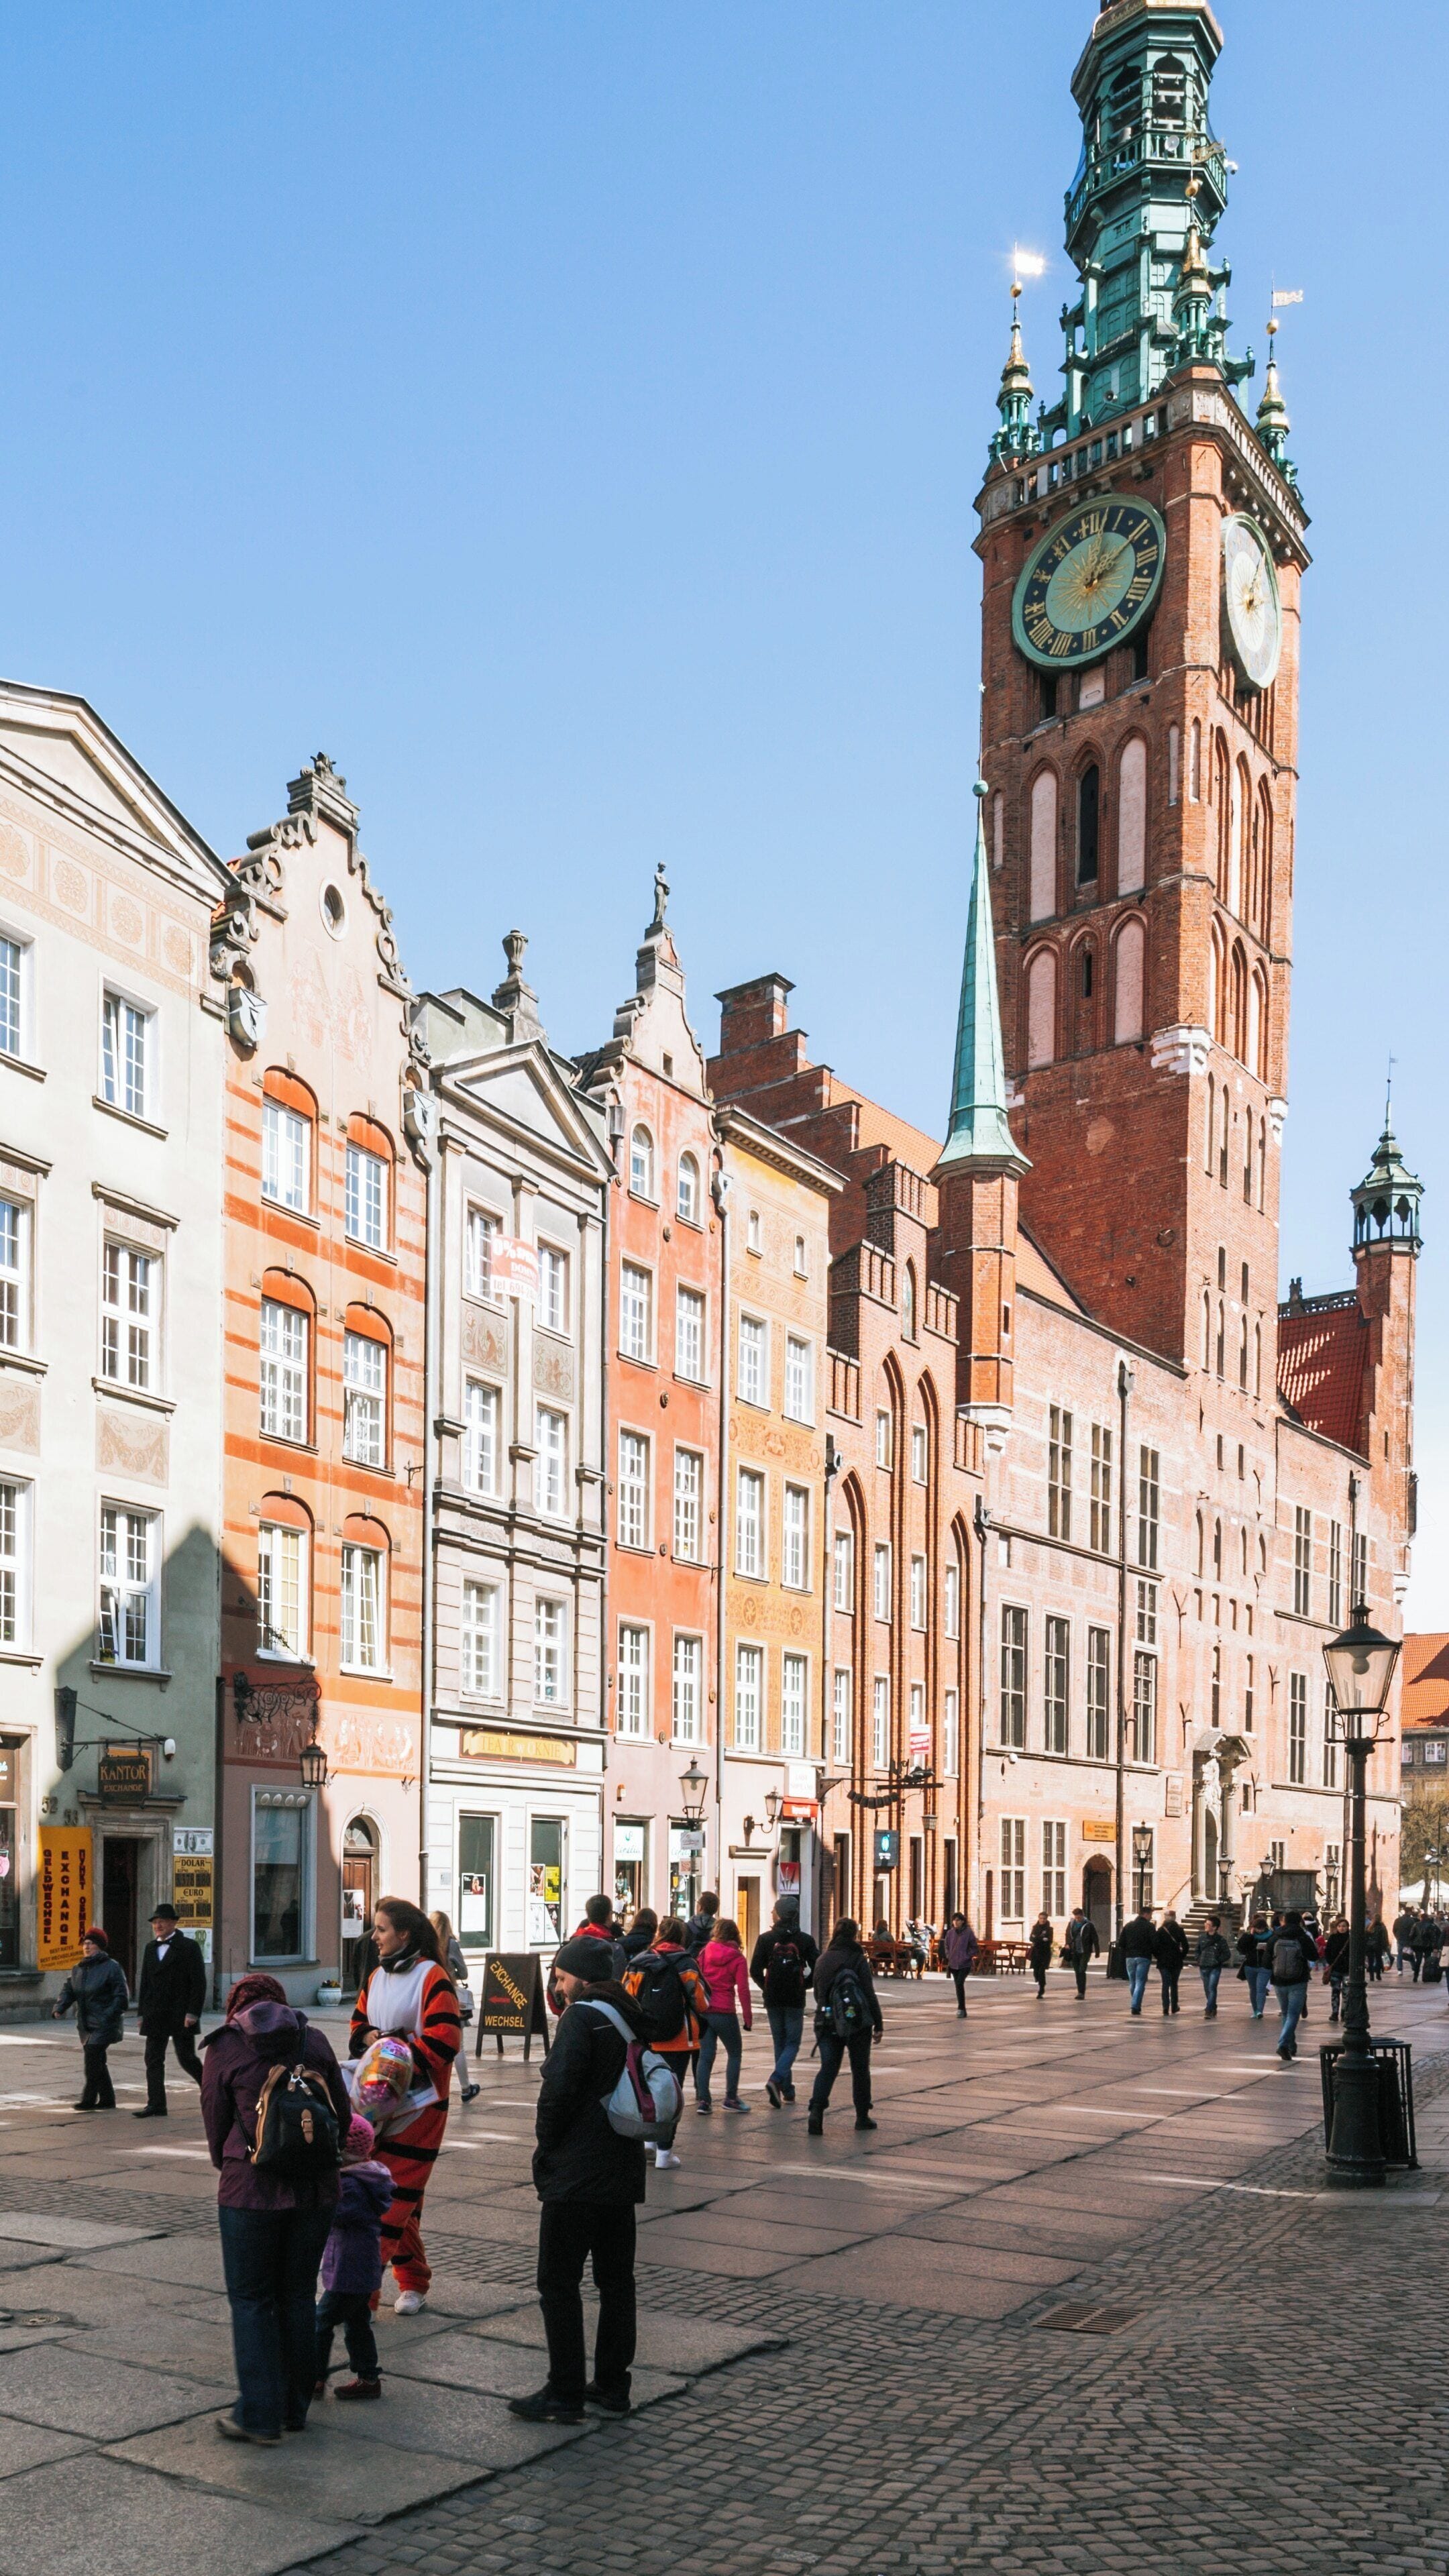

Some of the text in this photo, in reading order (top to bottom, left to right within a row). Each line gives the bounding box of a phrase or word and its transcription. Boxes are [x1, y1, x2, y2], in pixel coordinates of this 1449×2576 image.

[481, 1735, 515, 1753] TEATR
[527, 1741, 561, 1758] OKNIE
[101, 1765, 146, 1780] KANTOR
[103, 1784, 144, 1792] EXCHANGE
[181, 1859, 205, 1867] DOLAR
[42, 1849, 54, 1943] GELDWECHSEL
[60, 1851, 70, 1945] EXCHANGE
[490, 1961, 528, 2010] EXCHANGE
[484, 2016, 525, 2027] WECHSEL
